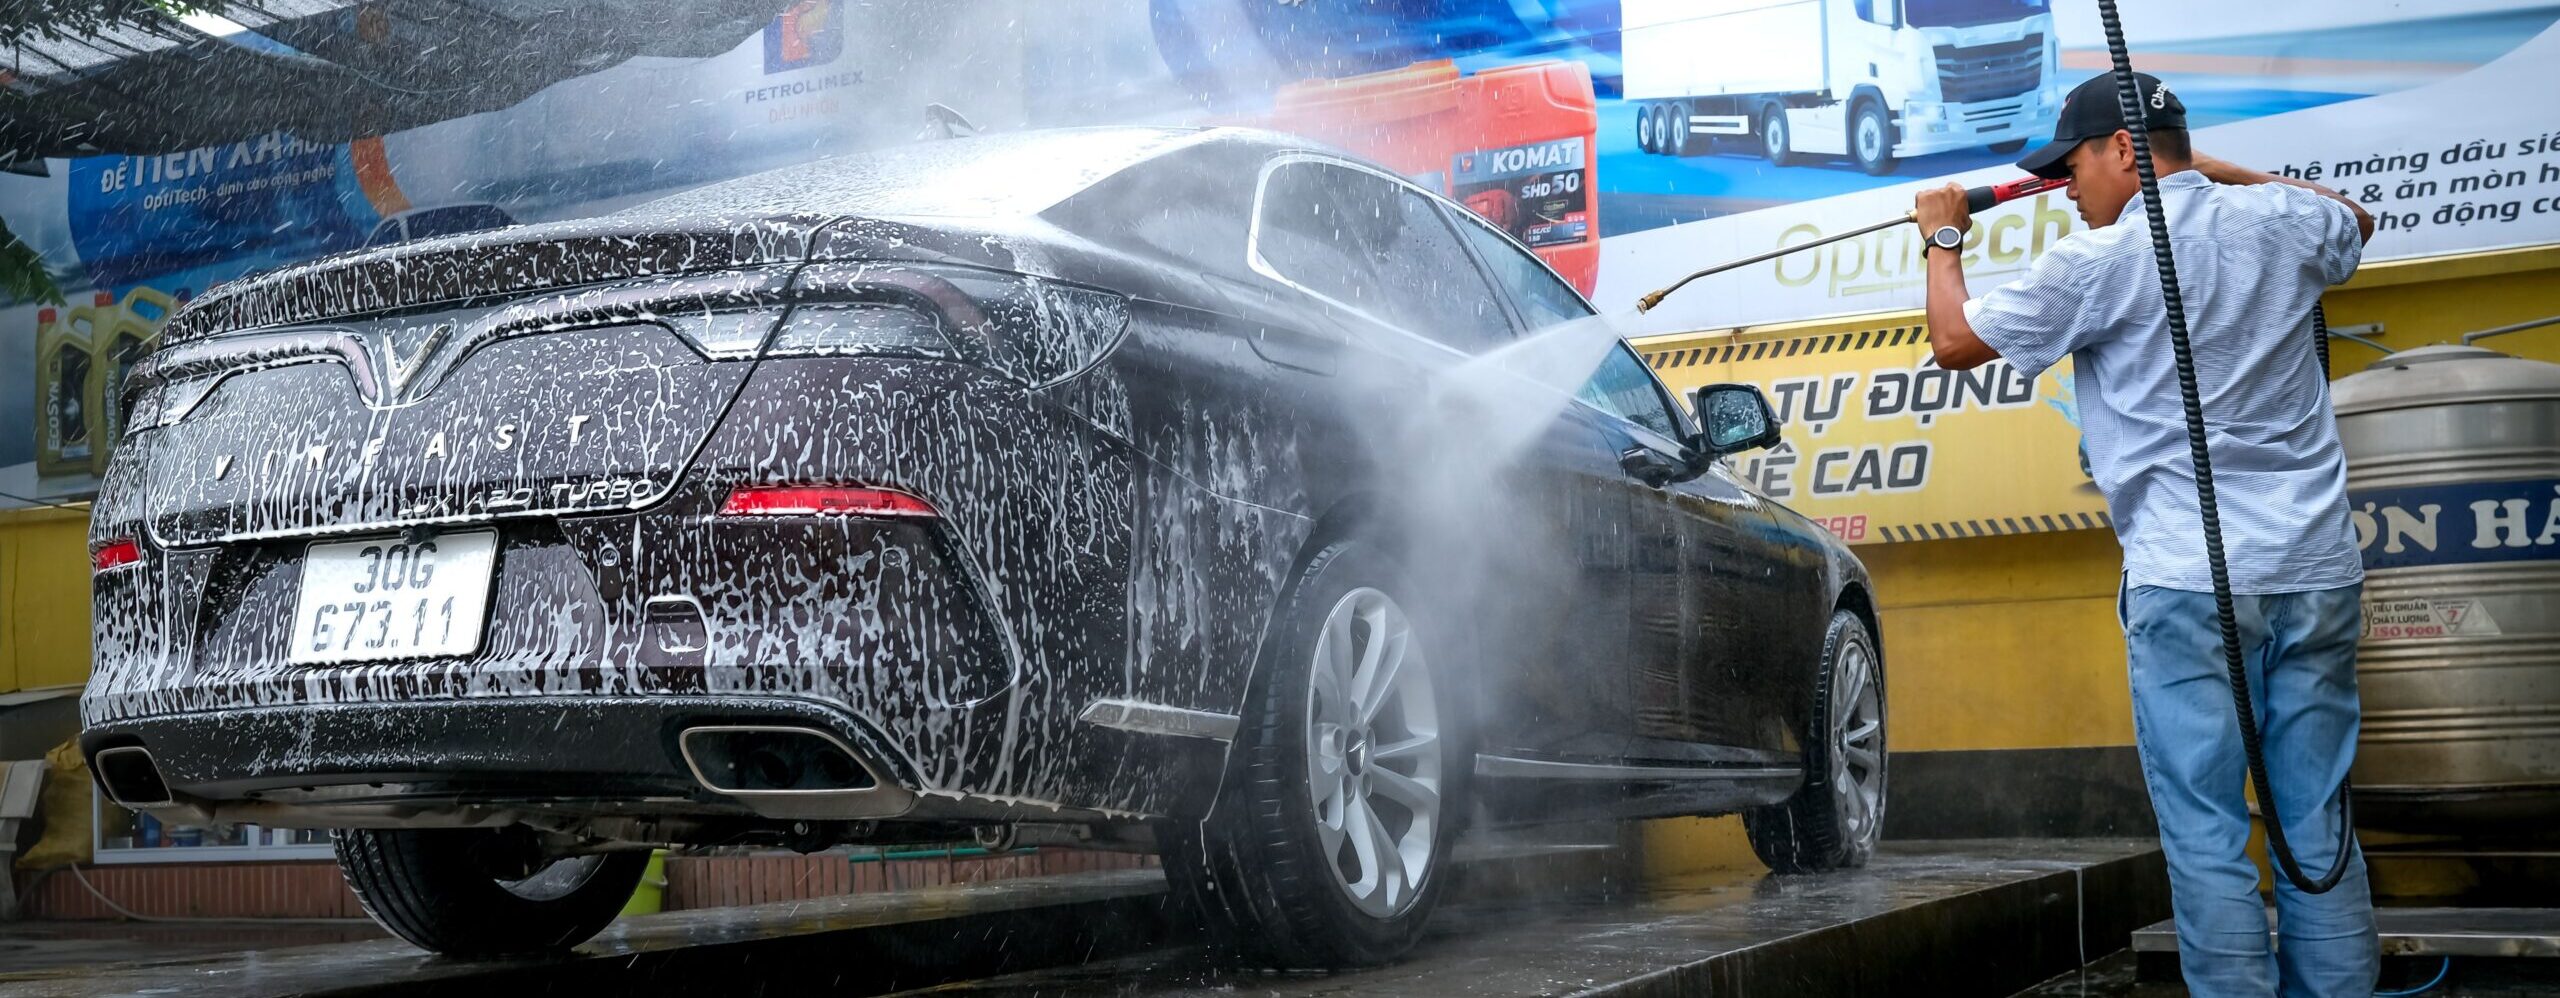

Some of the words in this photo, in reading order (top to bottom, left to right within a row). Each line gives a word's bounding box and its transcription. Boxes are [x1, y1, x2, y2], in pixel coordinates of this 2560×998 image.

[745, 70, 864, 103] PETROLIMEX
[1492, 142, 1577, 174] KOMAT
[2333, 151, 2430, 178] màng
[2440, 138, 2507, 165] dầu
[143, 185, 208, 212] OptiTech
[2360, 183, 2384, 204] &
[2395, 178, 2437, 201] ăn
[2449, 164, 2527, 194] mòn
[2432, 201, 2521, 227] động
[1774, 377, 1855, 434] TỰ
[1868, 356, 2035, 425] ĐỘNG
[1813, 445, 1928, 495] CAO
[550, 479, 652, 502] TURBO
[354, 541, 438, 593] 30G
[312, 596, 455, 653] 673.11
[2373, 626, 2402, 637] ISO
[2404, 624, 2444, 638] 9001
